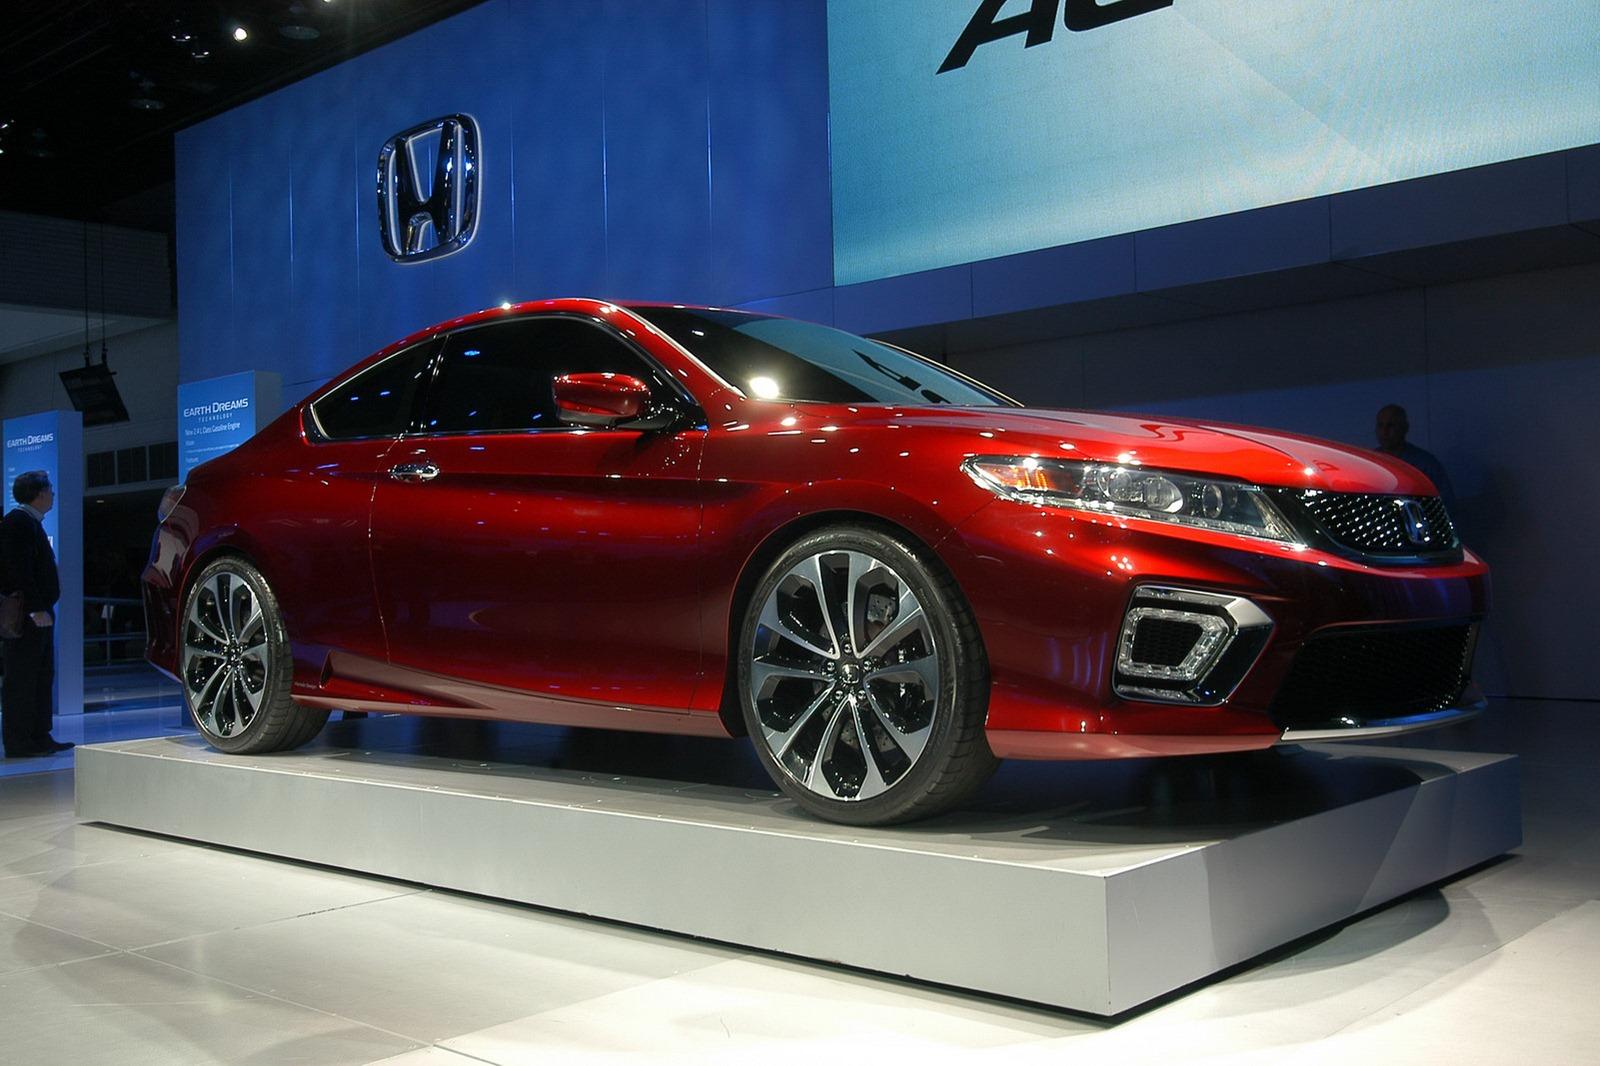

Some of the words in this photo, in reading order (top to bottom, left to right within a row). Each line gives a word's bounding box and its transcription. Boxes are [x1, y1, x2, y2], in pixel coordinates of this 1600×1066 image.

[936, 0, 1174, 75] A
[184, 405, 211, 417] EARTH
[213, 398, 248, 413] DREAMS
[199, 412, 233, 422] TECHNOLOGY
[7, 439, 27, 448] EARTH
[28, 433, 54, 445] DREAMS
